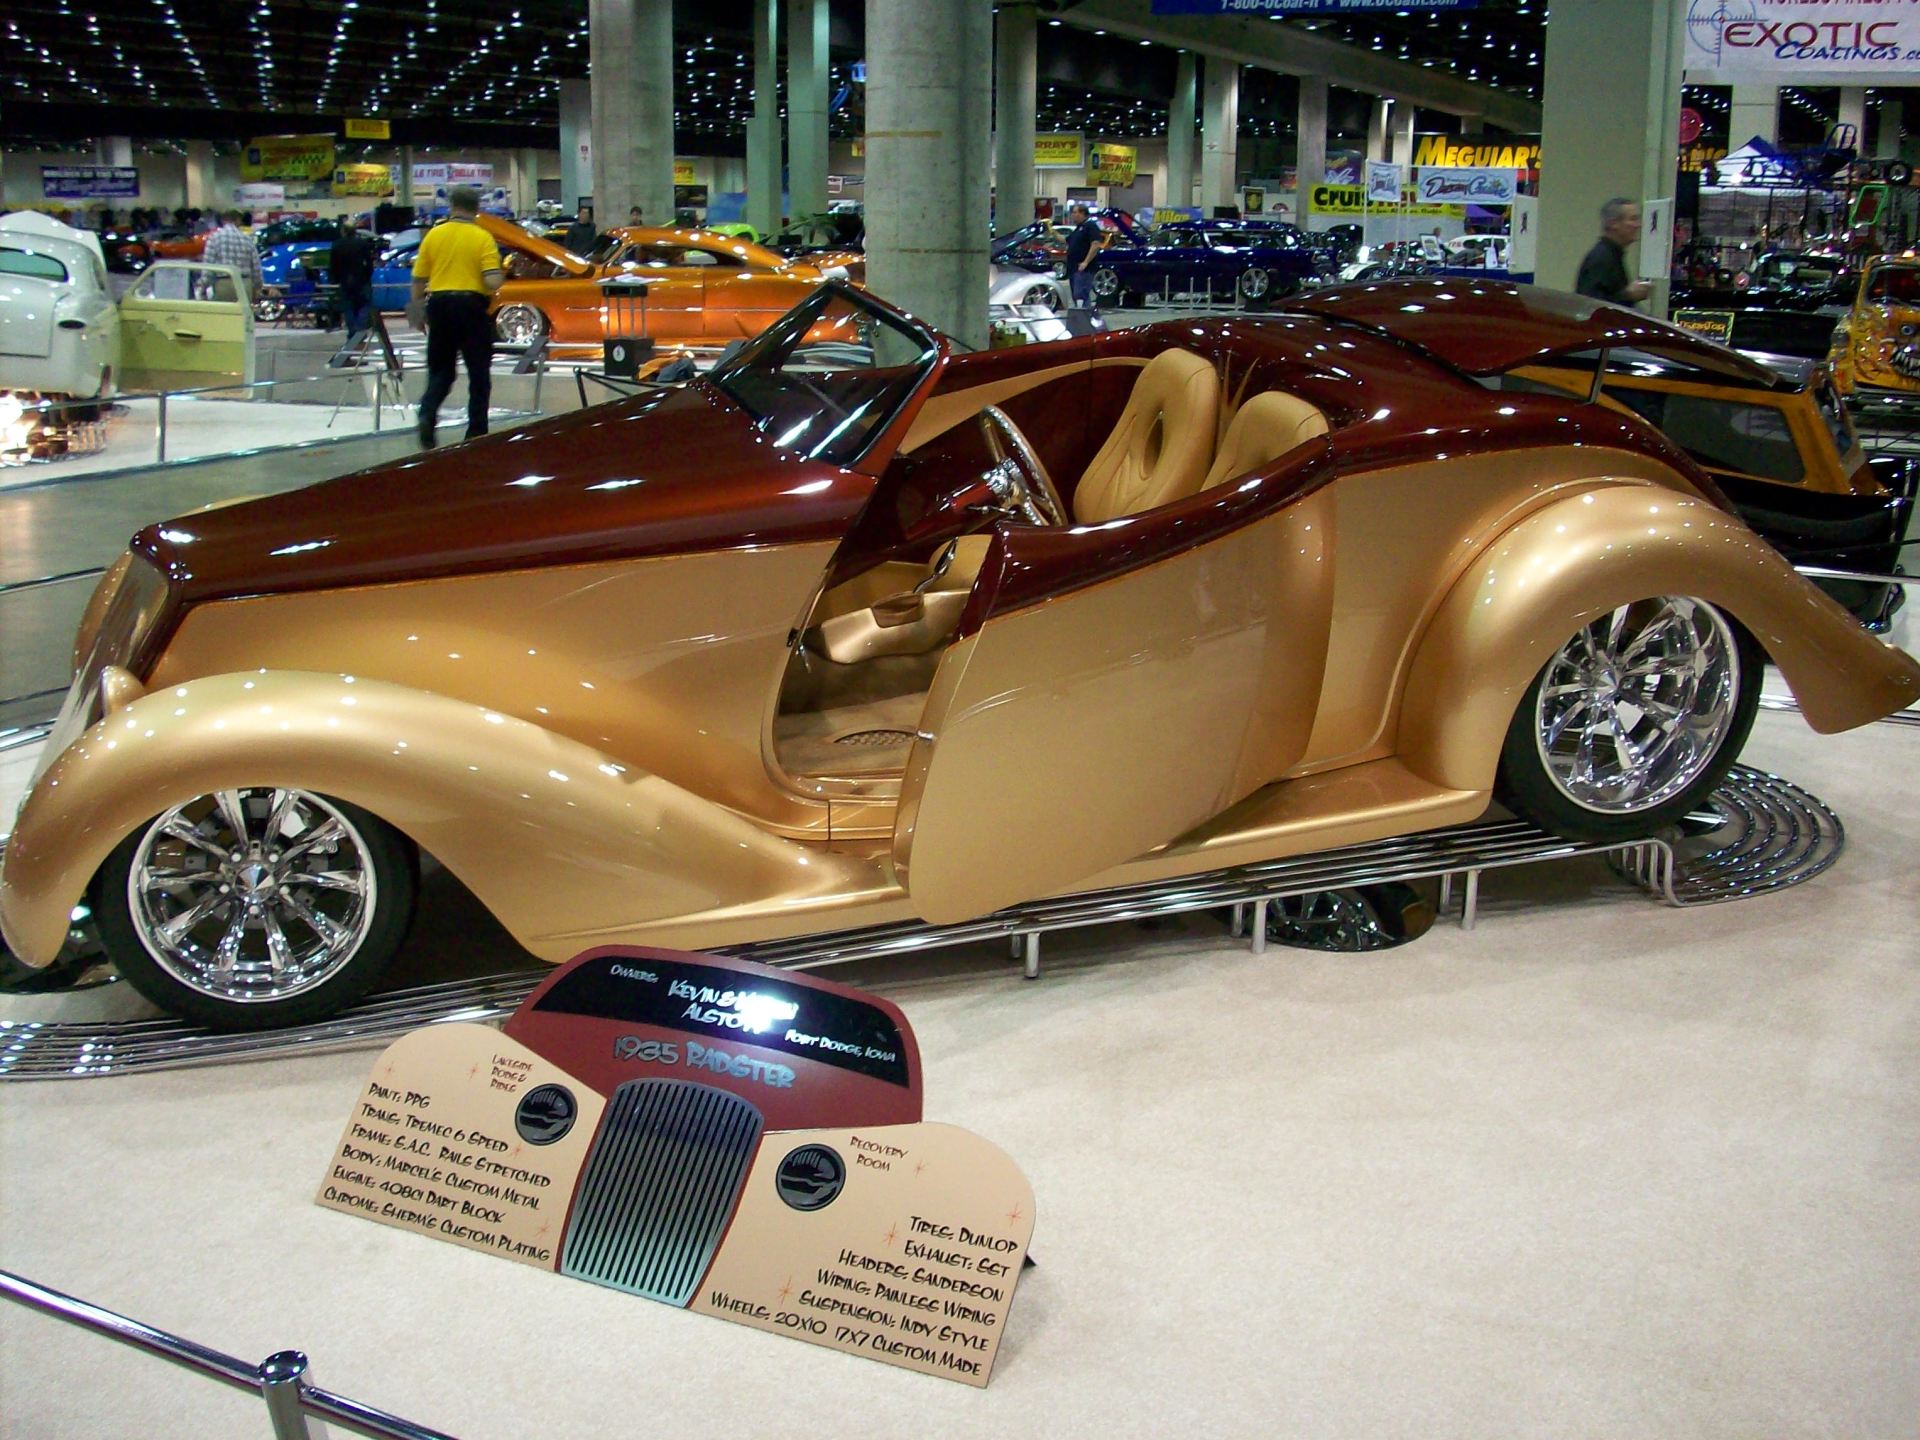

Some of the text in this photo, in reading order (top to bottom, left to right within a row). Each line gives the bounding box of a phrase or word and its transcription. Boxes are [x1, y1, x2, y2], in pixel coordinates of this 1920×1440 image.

[1724, 21, 1899, 49] EXOTIC
[667, 979, 720, 1003] KEVIN
[716, 990, 737, 1007] &
[614, 1035, 798, 1089] 1935 RADSTER
[785, 1029, 896, 1063] FORT DODGE, IOWA
[367, 1082, 431, 1109] PAINT: PPG
[361, 1103, 509, 1153] TRANS: TREMEC 6 SPEED
[849, 1136, 909, 1159] RECOVERY
[341, 1144, 540, 1210] BODY: MARCEL'S CUSTOM METAL
[350, 1124, 552, 1188] FRAME: S.A.C. RAILS STRETCHED
[856, 1153, 890, 1172] ROOM
[333, 1165, 376, 1188] ENGINE:
[426, 1191, 460, 1210] DART
[460, 1201, 506, 1224] BLOCK
[324, 1187, 550, 1262] CHROME: SHERM'S CUSTOM PLATING
[909, 1216, 1019, 1254] TIRES: DUNLOP
[838, 1248, 1004, 1303] HEADERS: SANDERSON
[904, 1240, 1011, 1279] EXHAUST: SST
[798, 1289, 990, 1352] SUSPENSION: INDY STYLE
[817, 1268, 996, 1327] WIRING: PAINLESS WIRING
[711, 1291, 983, 1377] WHEELS: 20X10 17X7 CUSTOM MADE
